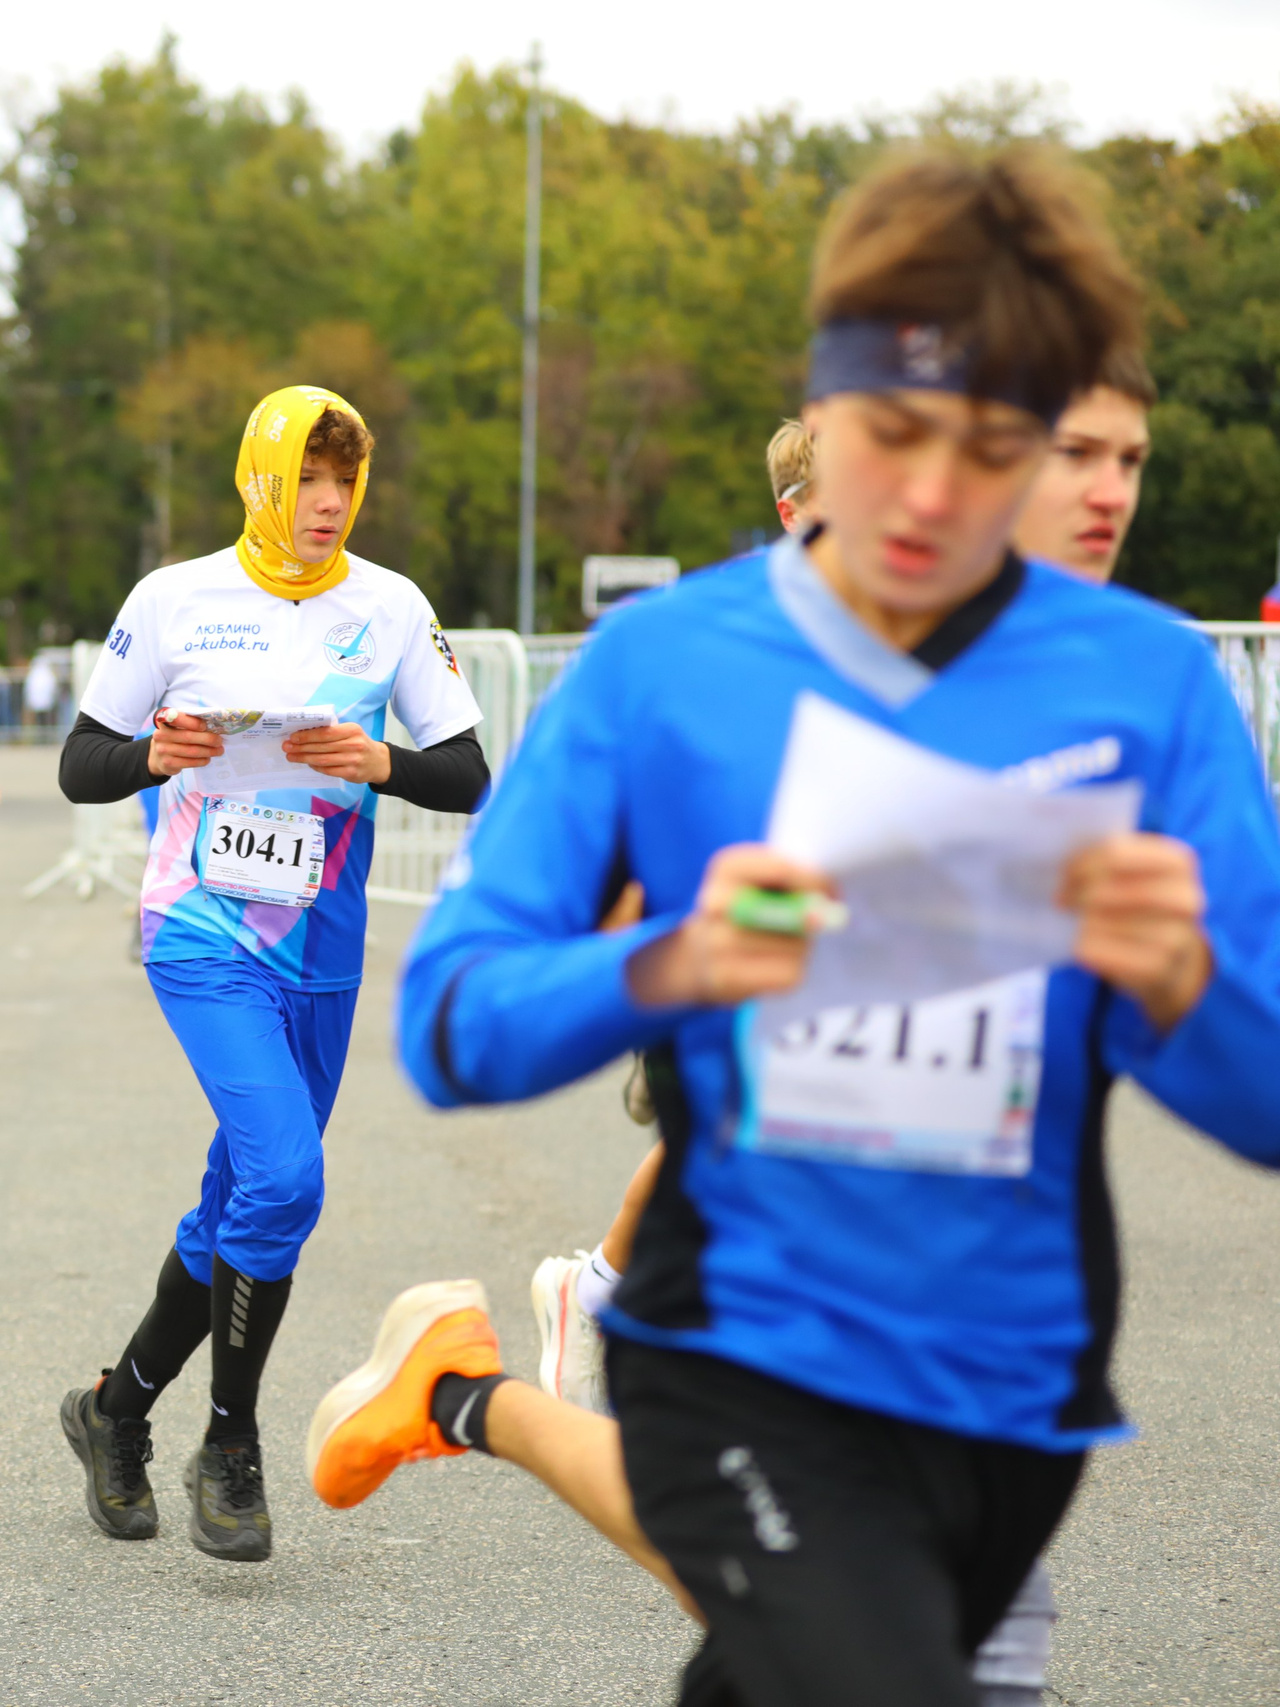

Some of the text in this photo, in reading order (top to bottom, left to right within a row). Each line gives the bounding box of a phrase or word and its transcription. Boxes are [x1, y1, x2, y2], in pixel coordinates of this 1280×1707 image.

[195, 623, 261, 635] ЛЮБЛИНО
[184, 636, 270, 652] o-kubok.ru
[211, 825, 304, 868] 304.1
